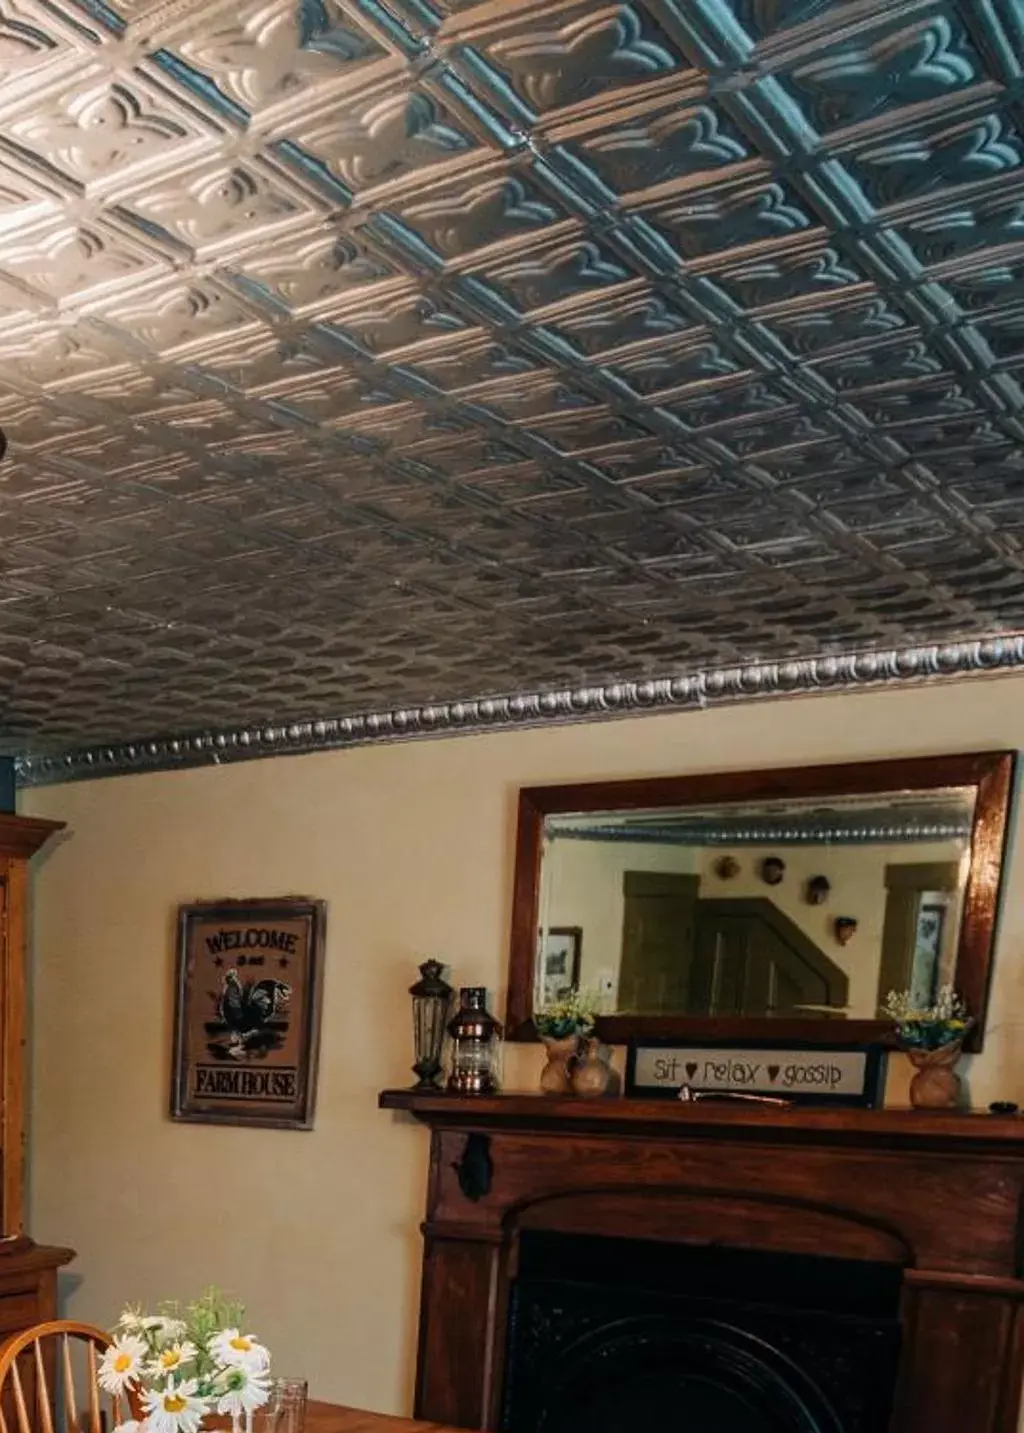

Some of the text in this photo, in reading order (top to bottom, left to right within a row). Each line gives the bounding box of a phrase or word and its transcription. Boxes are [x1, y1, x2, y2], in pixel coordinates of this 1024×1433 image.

[205, 928, 299, 954] WELCOME
[703, 1060, 760, 1083] relax
[782, 1065, 842, 1090] gossip
